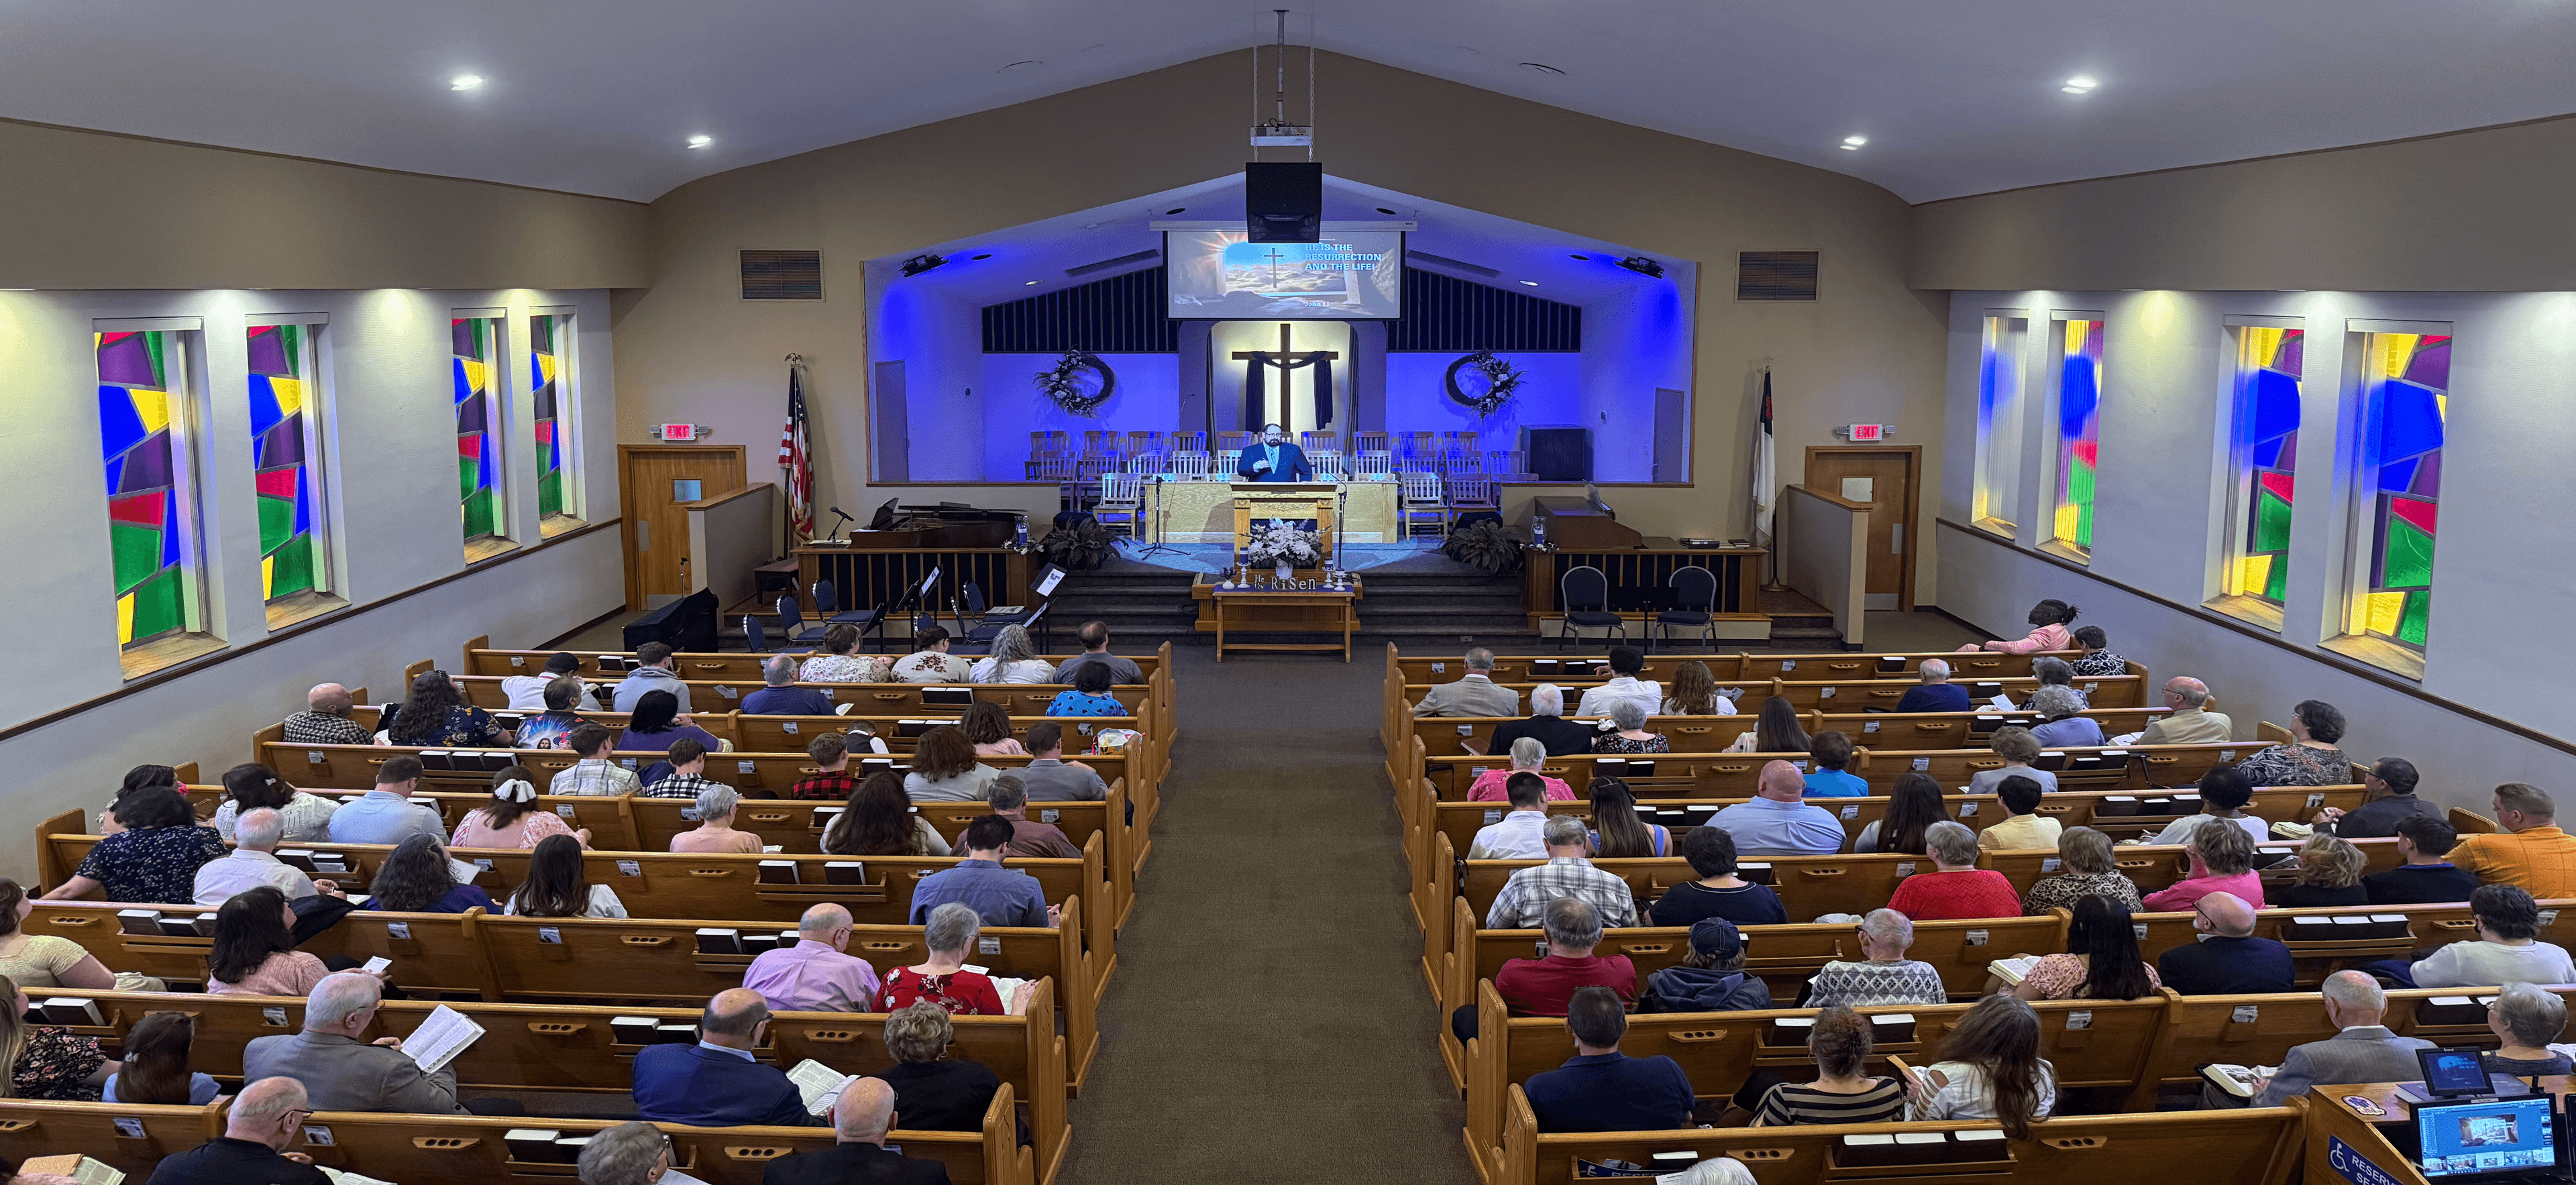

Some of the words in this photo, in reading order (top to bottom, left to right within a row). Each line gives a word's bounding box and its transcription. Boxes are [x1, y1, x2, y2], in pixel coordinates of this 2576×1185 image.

[666, 424, 690, 439] EXIT
[1855, 425, 1879, 439] EXIT
[1254, 574, 1265, 583] He
